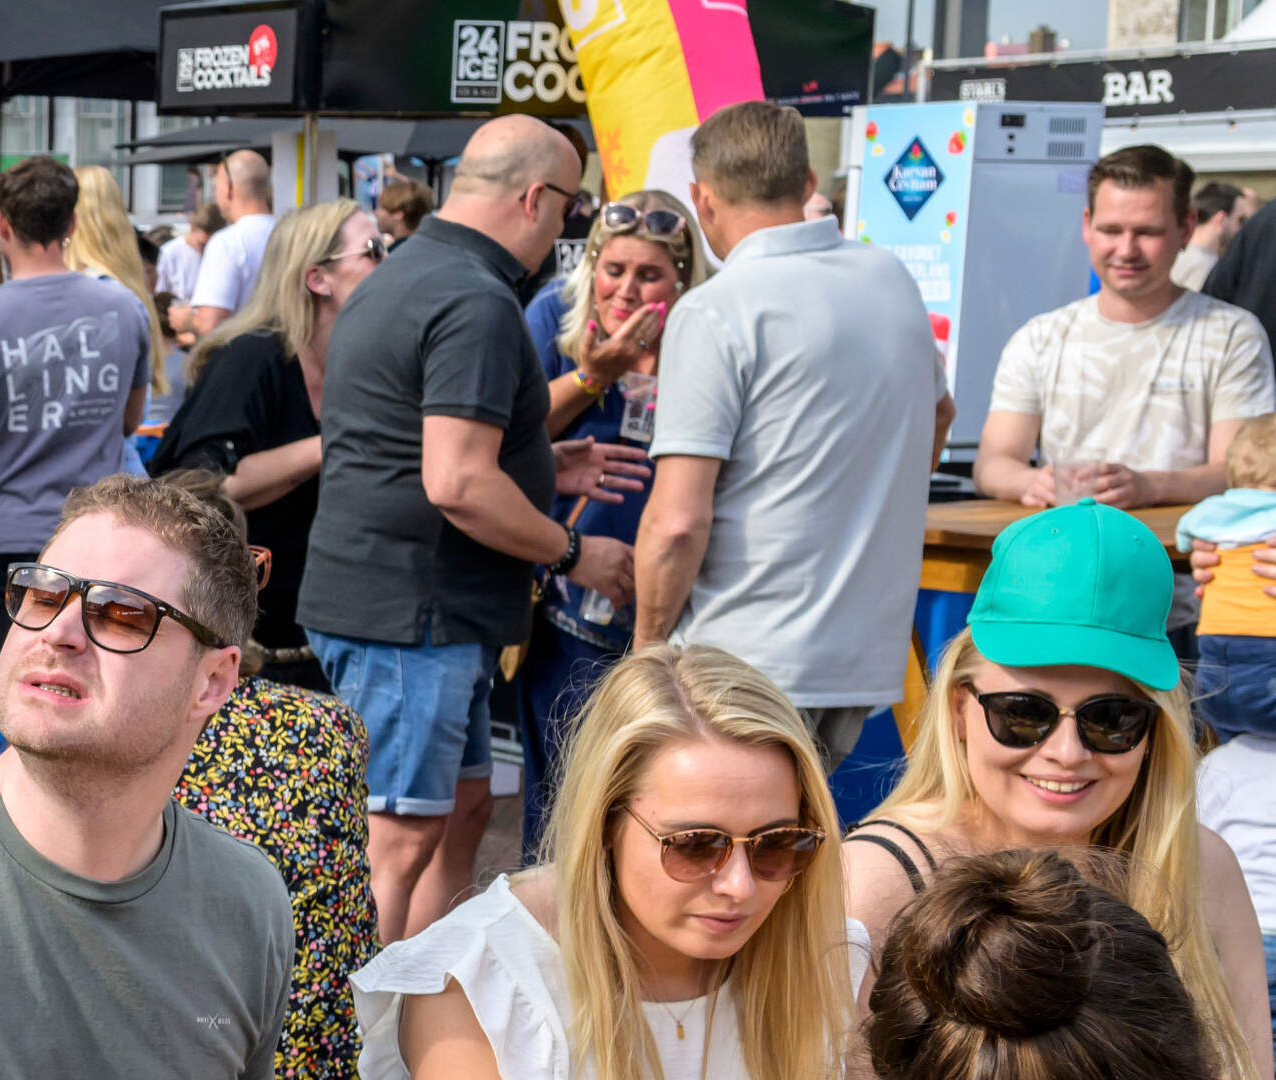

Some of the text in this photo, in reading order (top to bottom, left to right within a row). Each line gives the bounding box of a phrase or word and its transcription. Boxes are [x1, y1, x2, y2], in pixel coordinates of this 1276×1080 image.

[459, 26, 499, 56] 24
[194, 44, 250, 68] FROZEN
[457, 56, 498, 80] ICE
[193, 64, 271, 90] COCKTAILS
[1103, 70, 1175, 106] BAR
